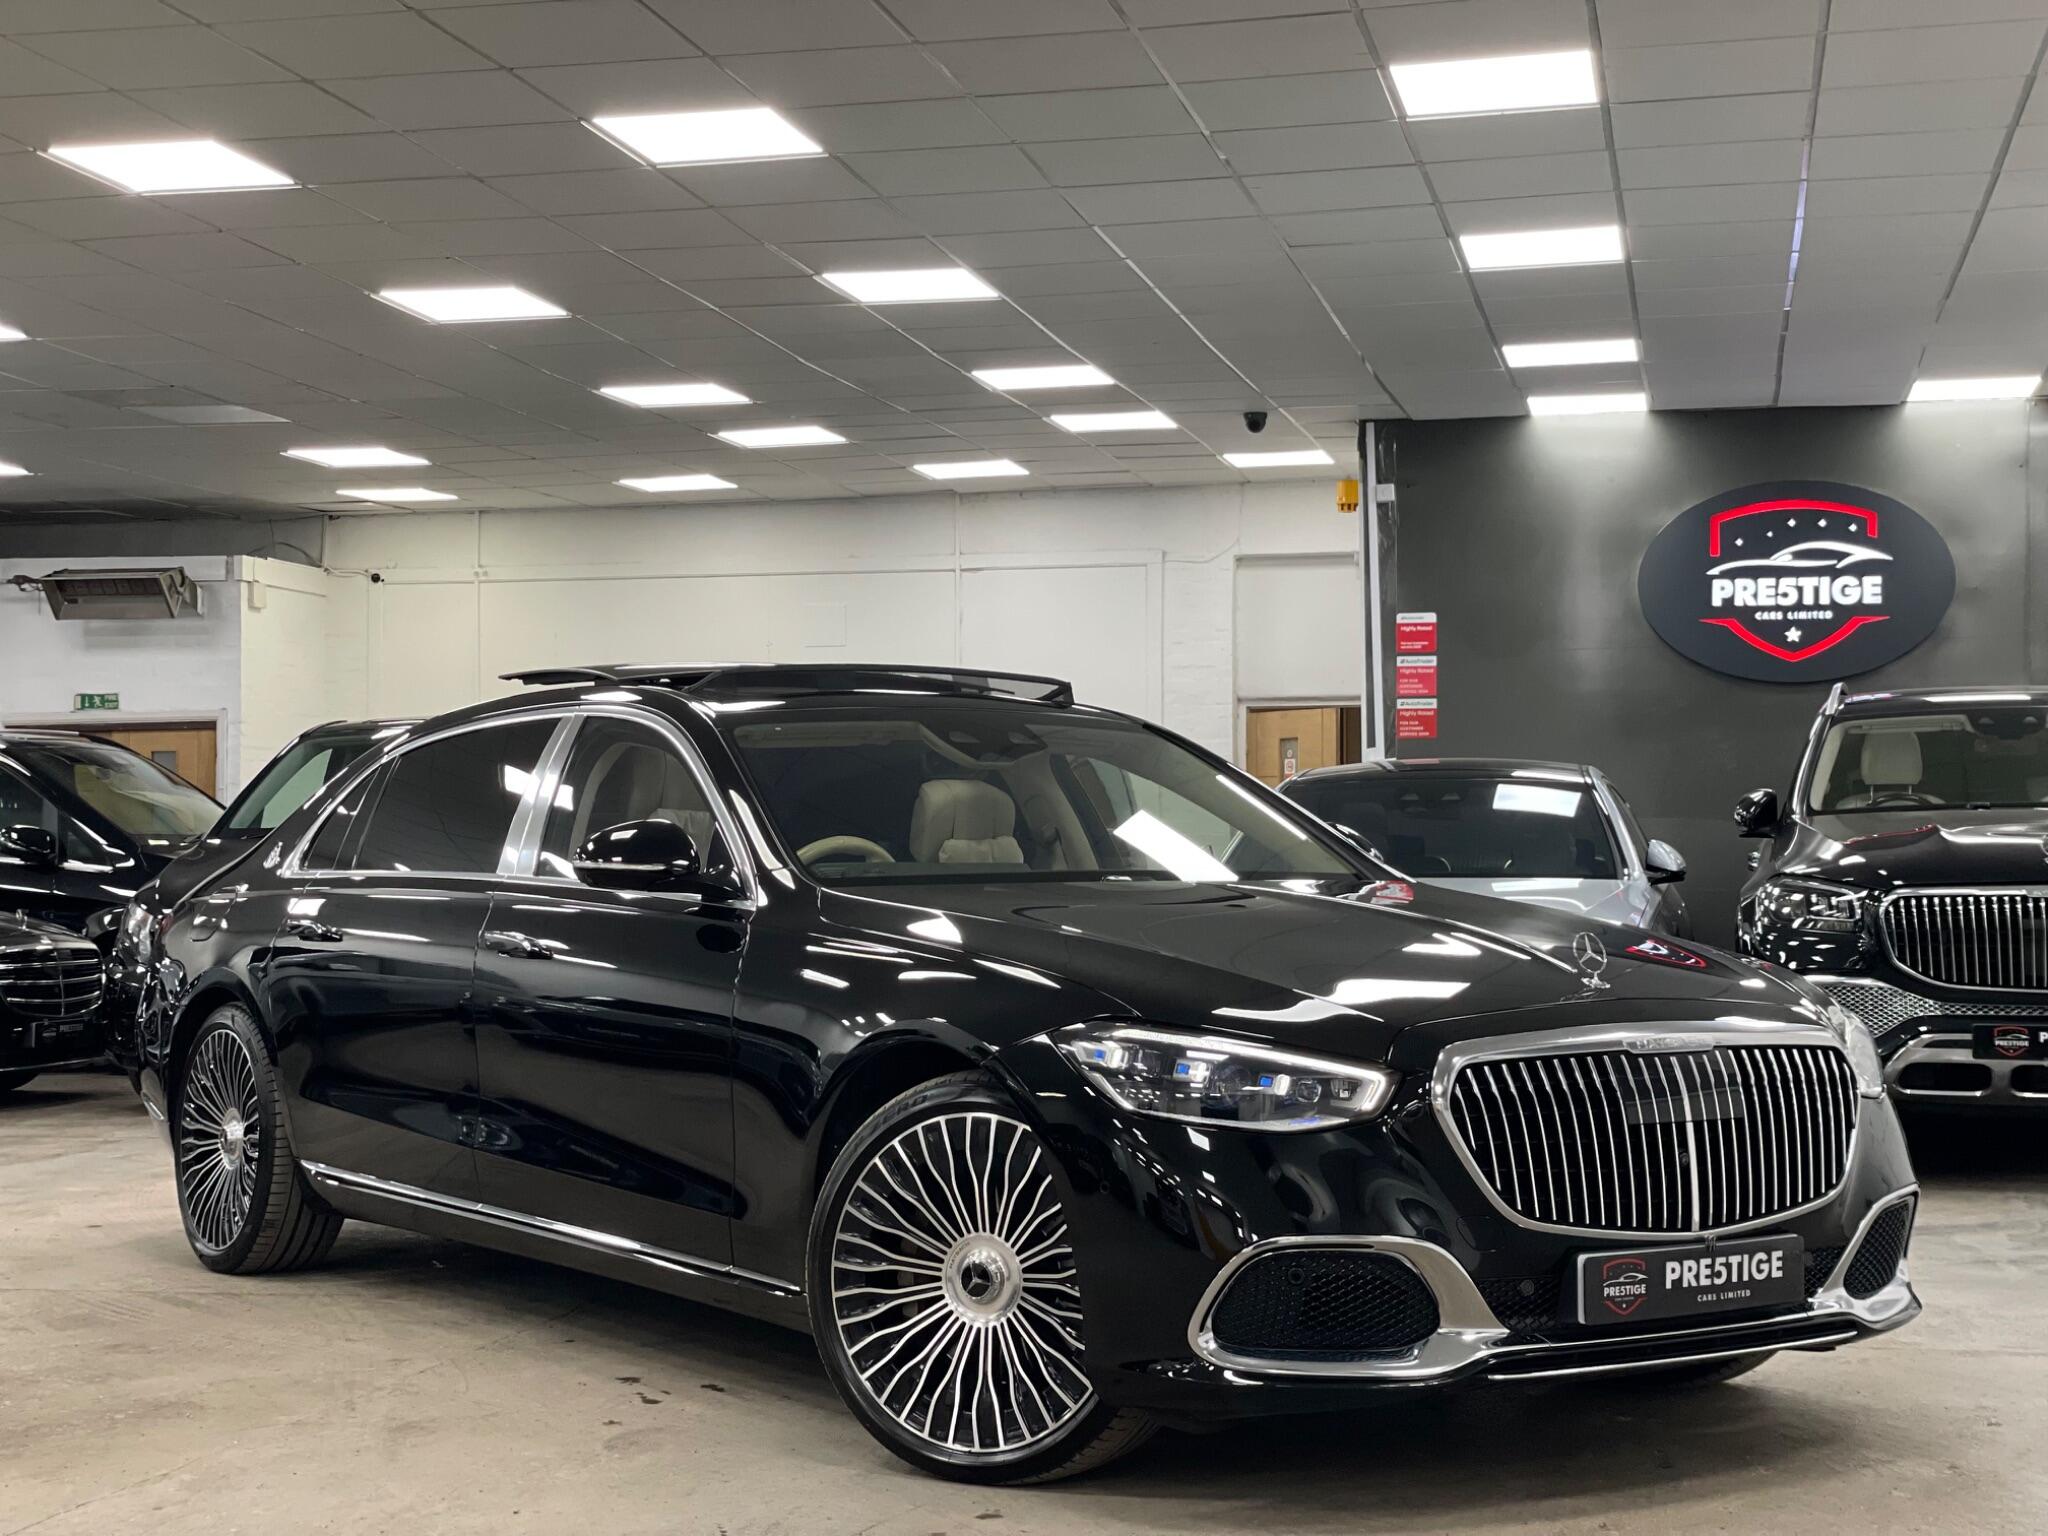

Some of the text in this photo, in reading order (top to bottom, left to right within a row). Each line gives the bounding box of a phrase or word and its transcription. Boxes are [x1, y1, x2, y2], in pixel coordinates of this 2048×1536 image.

[1754, 609, 1834, 621] CARS LIMITED
[1697, 1289, 1751, 1302] CARS LIMITED
